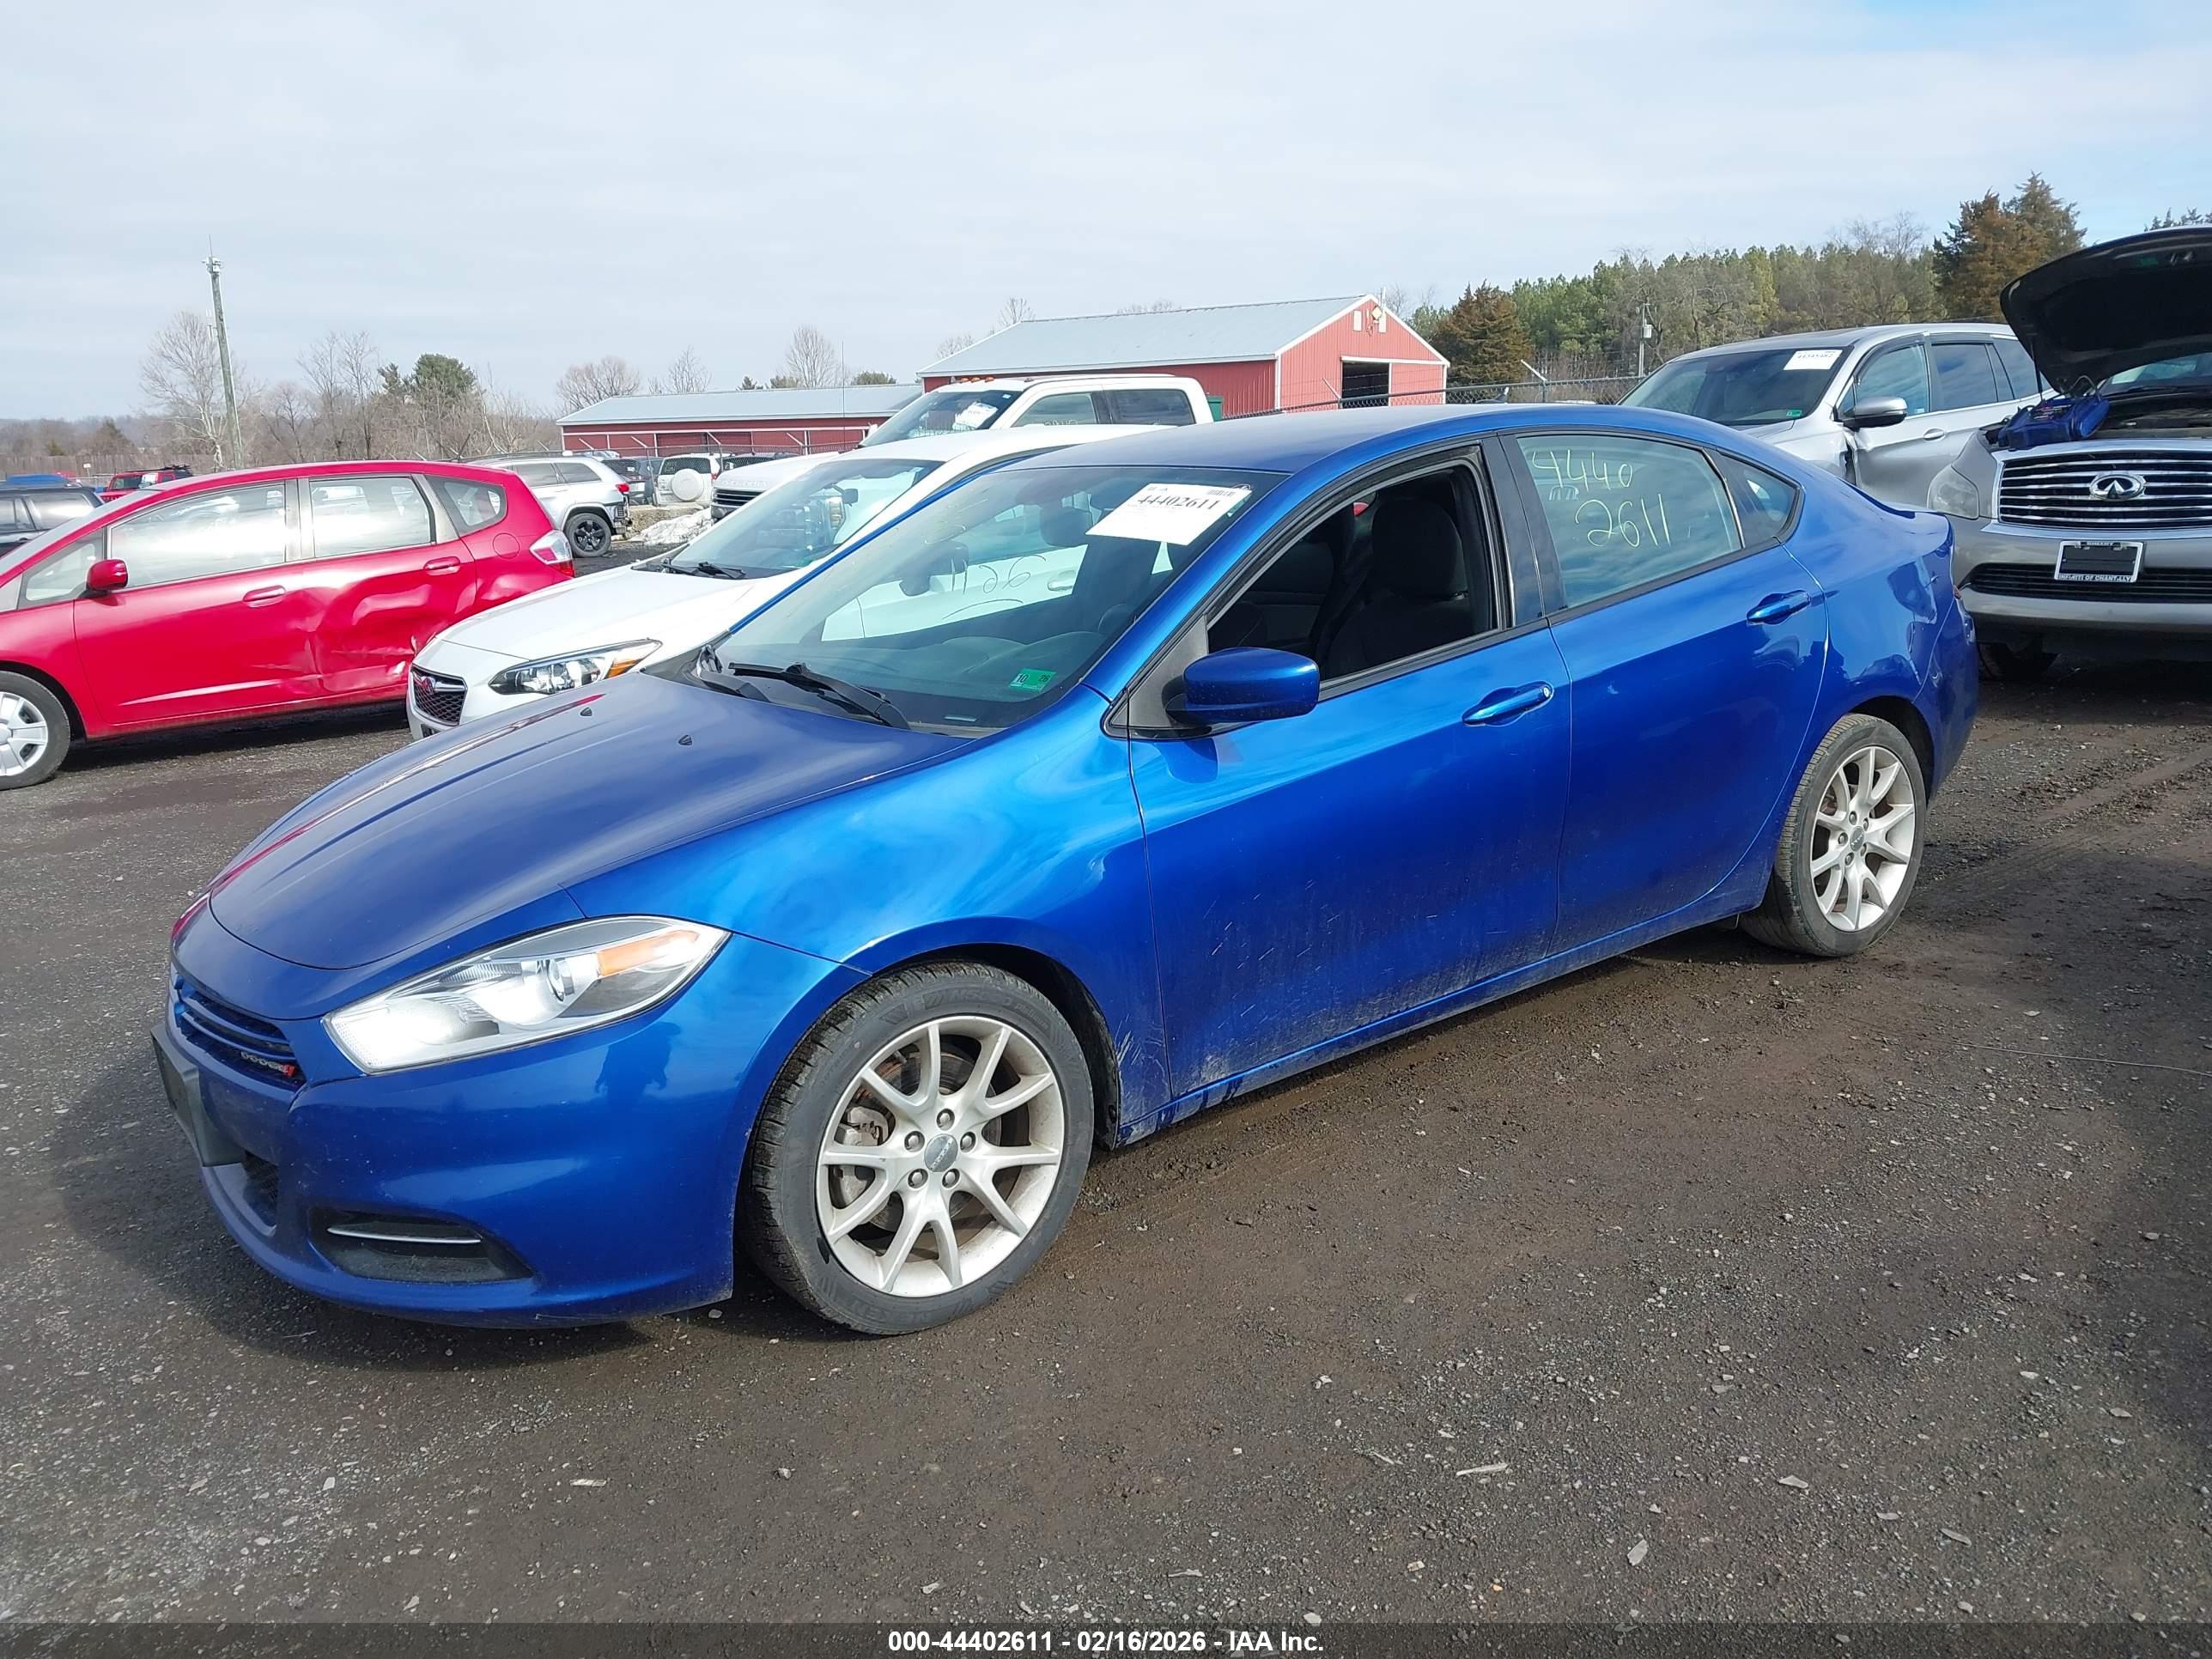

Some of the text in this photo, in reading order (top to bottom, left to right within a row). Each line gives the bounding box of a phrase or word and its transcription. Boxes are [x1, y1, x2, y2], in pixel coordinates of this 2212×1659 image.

[1533, 449, 1633, 491] 4440
[1138, 495, 1220, 509] 44402611
[1575, 493, 1671, 548] 2611
[1018, 674, 1028, 684] 10
